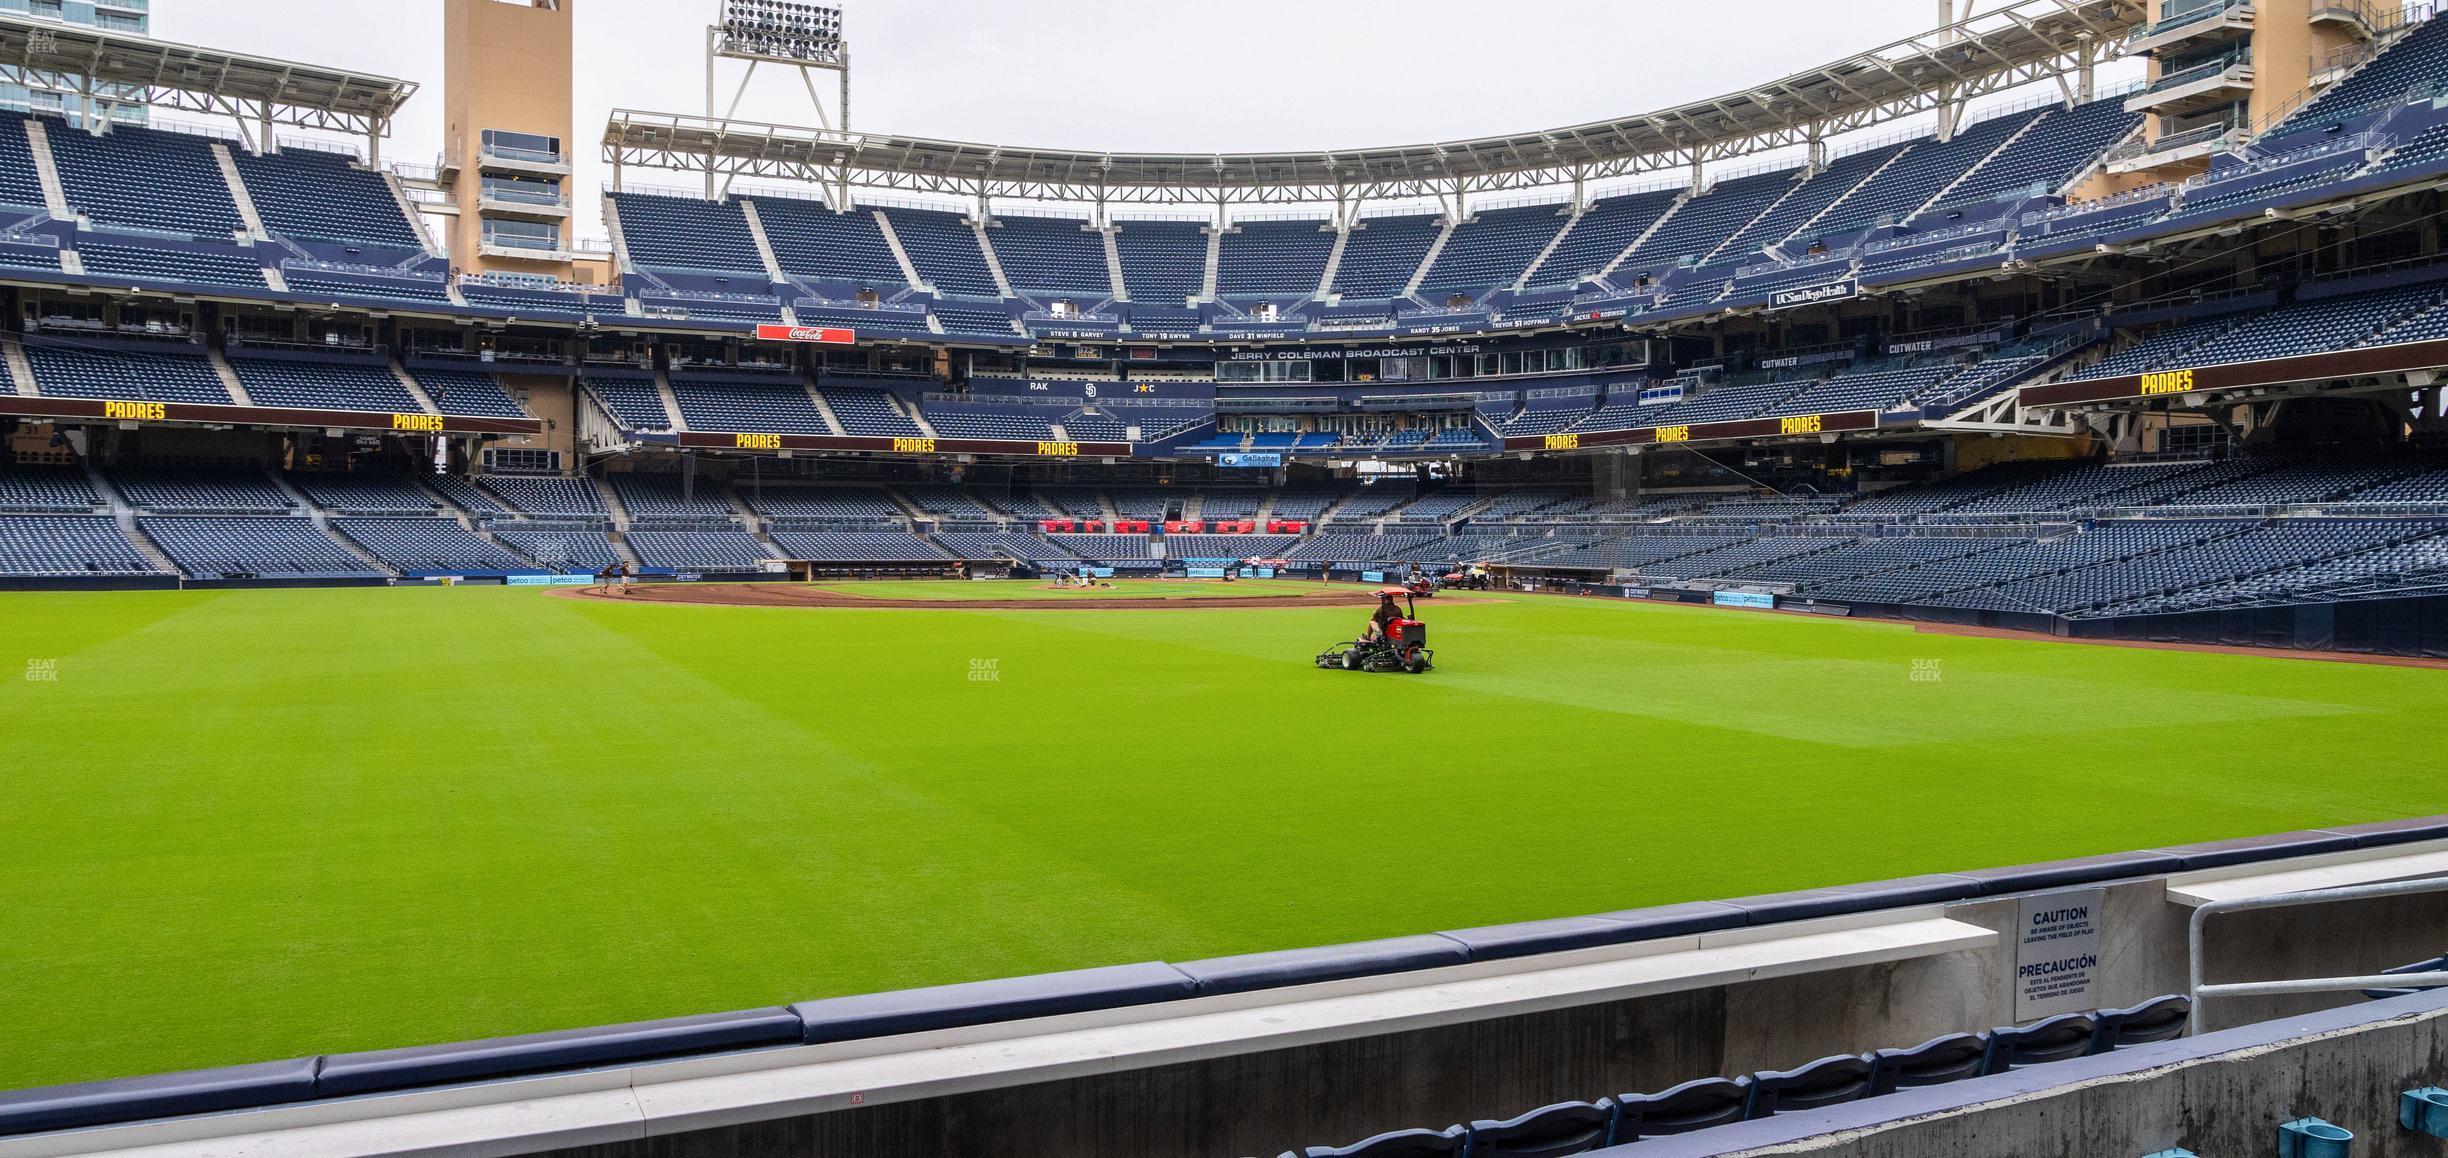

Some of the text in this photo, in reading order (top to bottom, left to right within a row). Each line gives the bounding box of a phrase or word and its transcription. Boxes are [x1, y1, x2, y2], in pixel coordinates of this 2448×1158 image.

[1600, 310, 1627, 318] ROBINSON
[1278, 351, 1341, 359] COLEMAN
[1346, 348, 1425, 358] BROADCAST
[1430, 345, 1479, 355] CENTER
[1889, 340, 1931, 354] CUTWATER
[1762, 357, 1797, 368] CUTWATER
[2140, 370, 2193, 396] PADRES
[104, 400, 166, 420] PADRES
[393, 414, 444, 431] PADRES
[1781, 415, 1822, 433] PADRES
[736, 434, 780, 448] PADRES
[1656, 426, 1688, 442] PADRES
[894, 438, 934, 452] PADRES
[1545, 434, 1578, 449] PADRES
[1038, 442, 1078, 456] PADRES
[1744, 596, 1758, 604] petco
[2034, 906, 2088, 925] CAUTION
[2067, 921, 2089, 930] OBJECTS
[2019, 953, 2096, 978] PRECAUCIÓN
[2051, 973, 2078, 982] PENDIENTE
[2024, 986, 2047, 994] OBJETOS
[2059, 979, 2090, 988] ABANDONAN
[2037, 991, 2060, 1000] TERRENO
